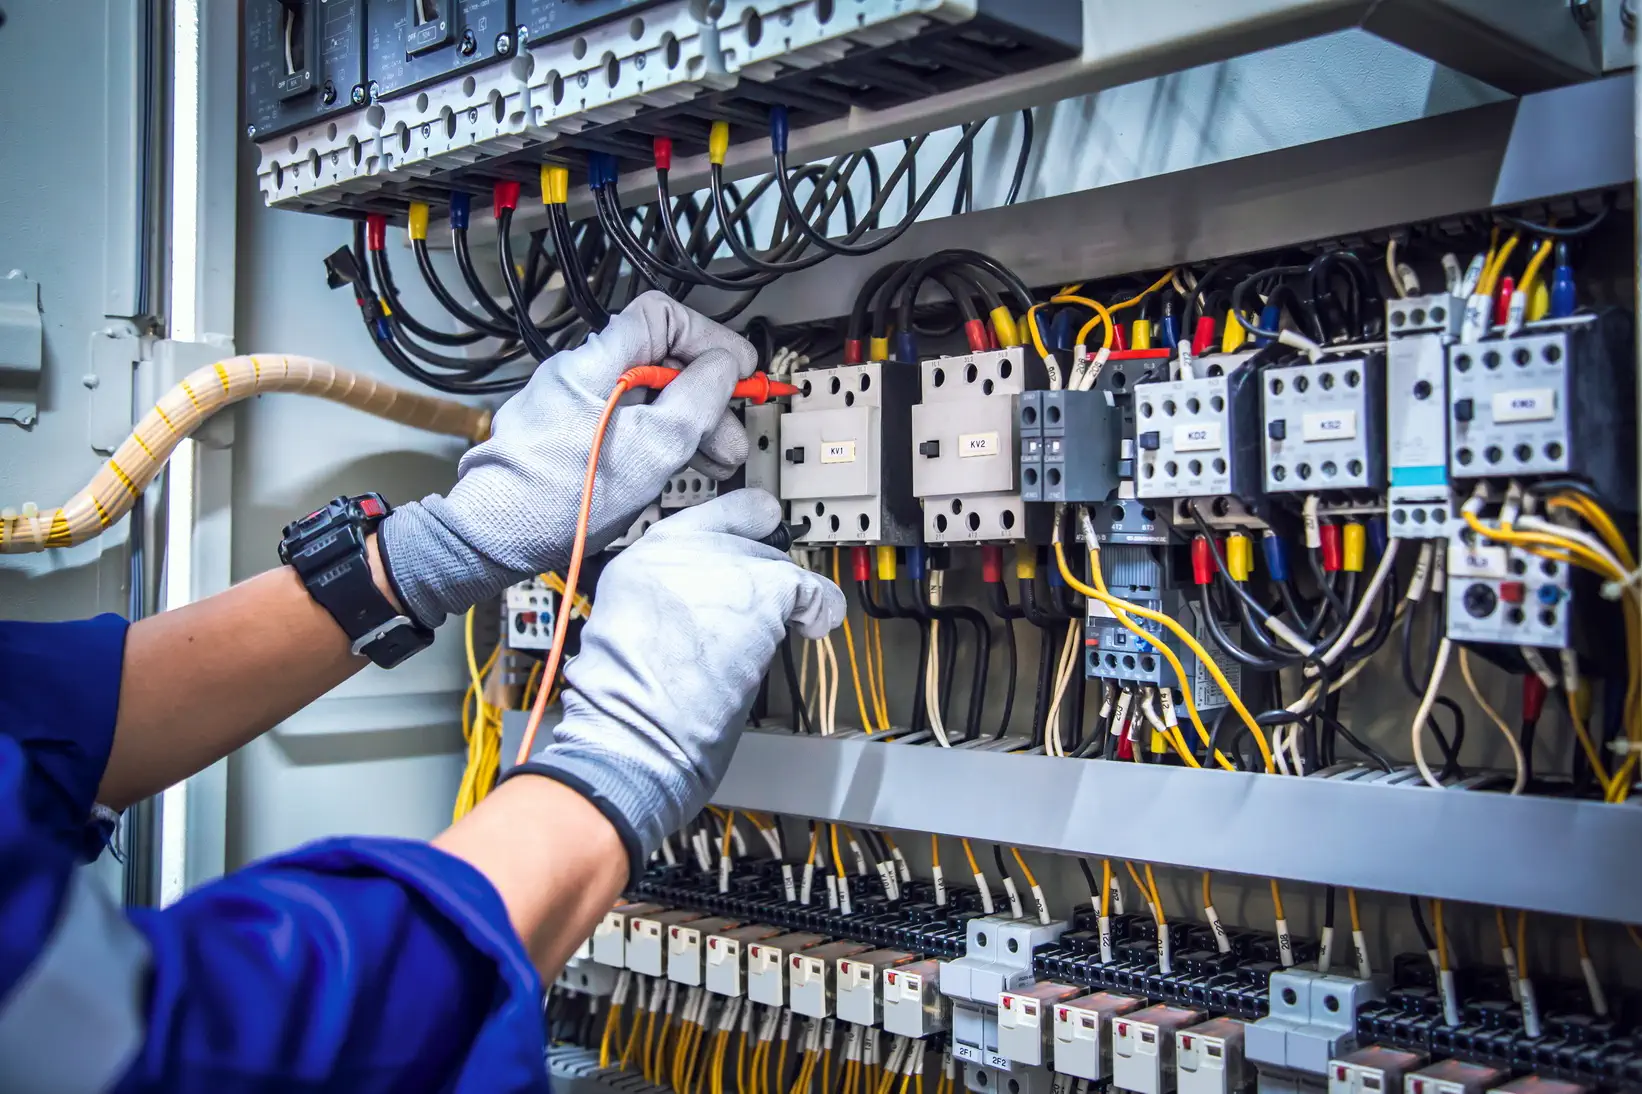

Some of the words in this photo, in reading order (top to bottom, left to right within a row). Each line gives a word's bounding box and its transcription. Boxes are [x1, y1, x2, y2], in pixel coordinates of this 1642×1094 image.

[970, 440, 986, 448] KV2
[830, 447, 843, 455] KV1
[1102, 933, 1110, 948] 221
[1280, 933, 1290, 951] 208
[959, 1047, 972, 1058] 2F1
[992, 1056, 1007, 1067] 2F2
